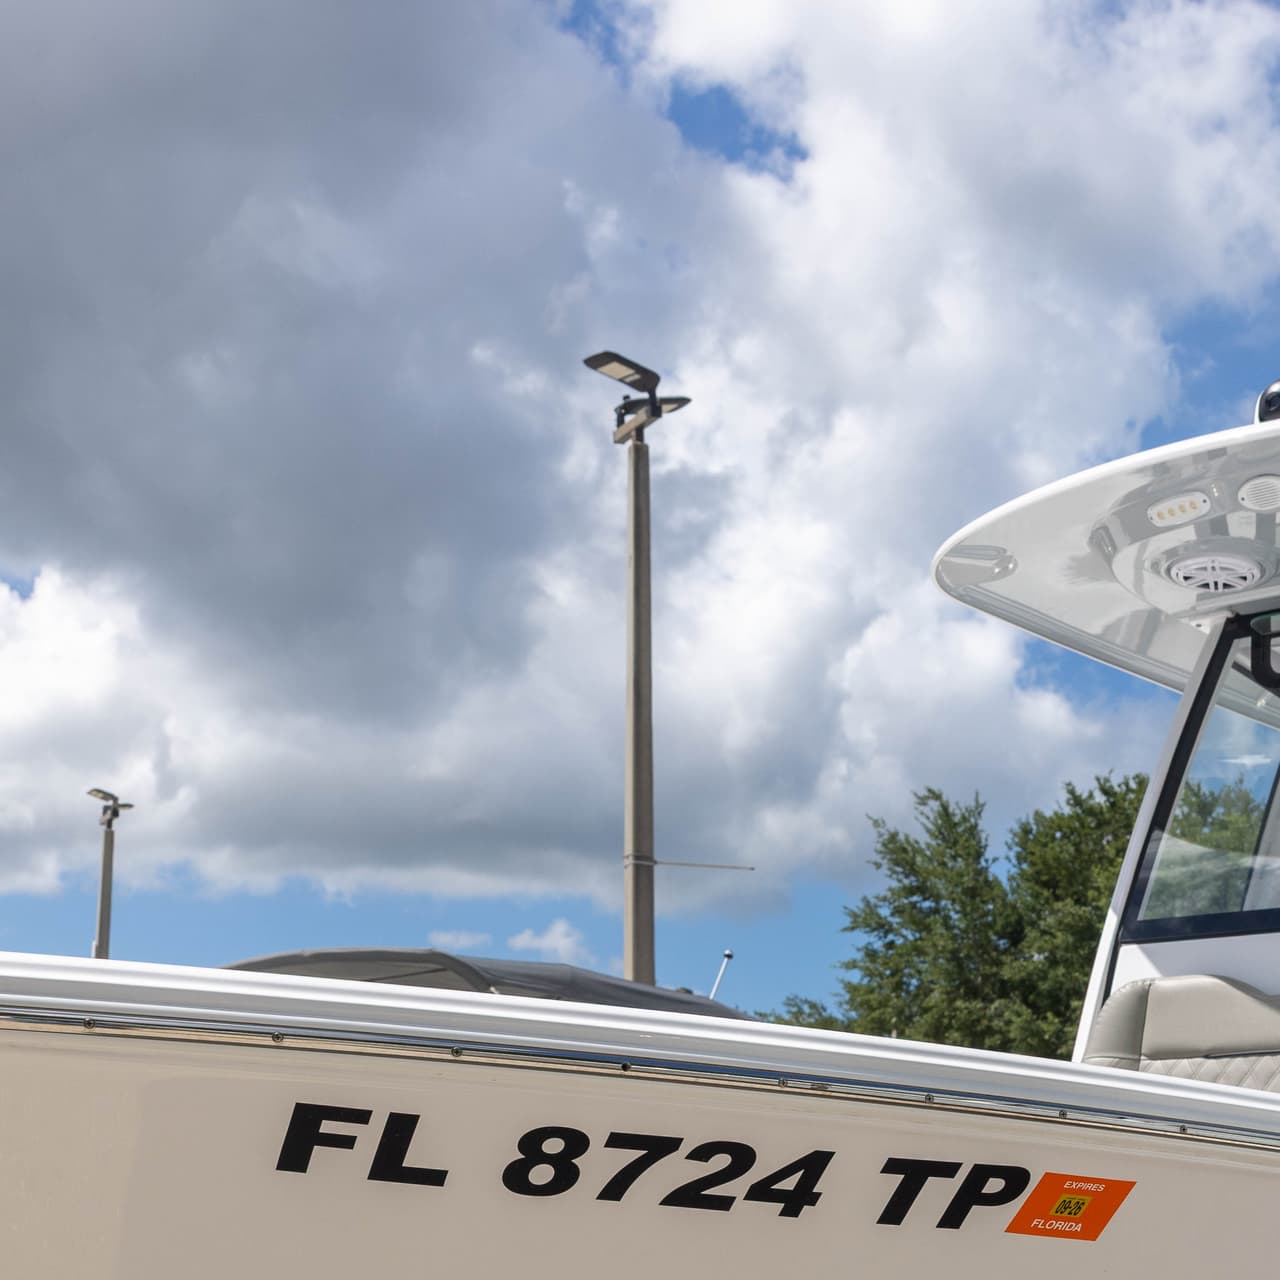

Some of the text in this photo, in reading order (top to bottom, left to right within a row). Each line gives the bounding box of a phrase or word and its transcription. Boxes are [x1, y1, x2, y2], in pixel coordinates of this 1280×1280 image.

[276, 1102, 1031, 1230] FL 8724 TP
[1063, 1180, 1105, 1192] EXPIRES
[1055, 1199, 1085, 1216] 09-26
[1030, 1218, 1082, 1232] FLORIDA
